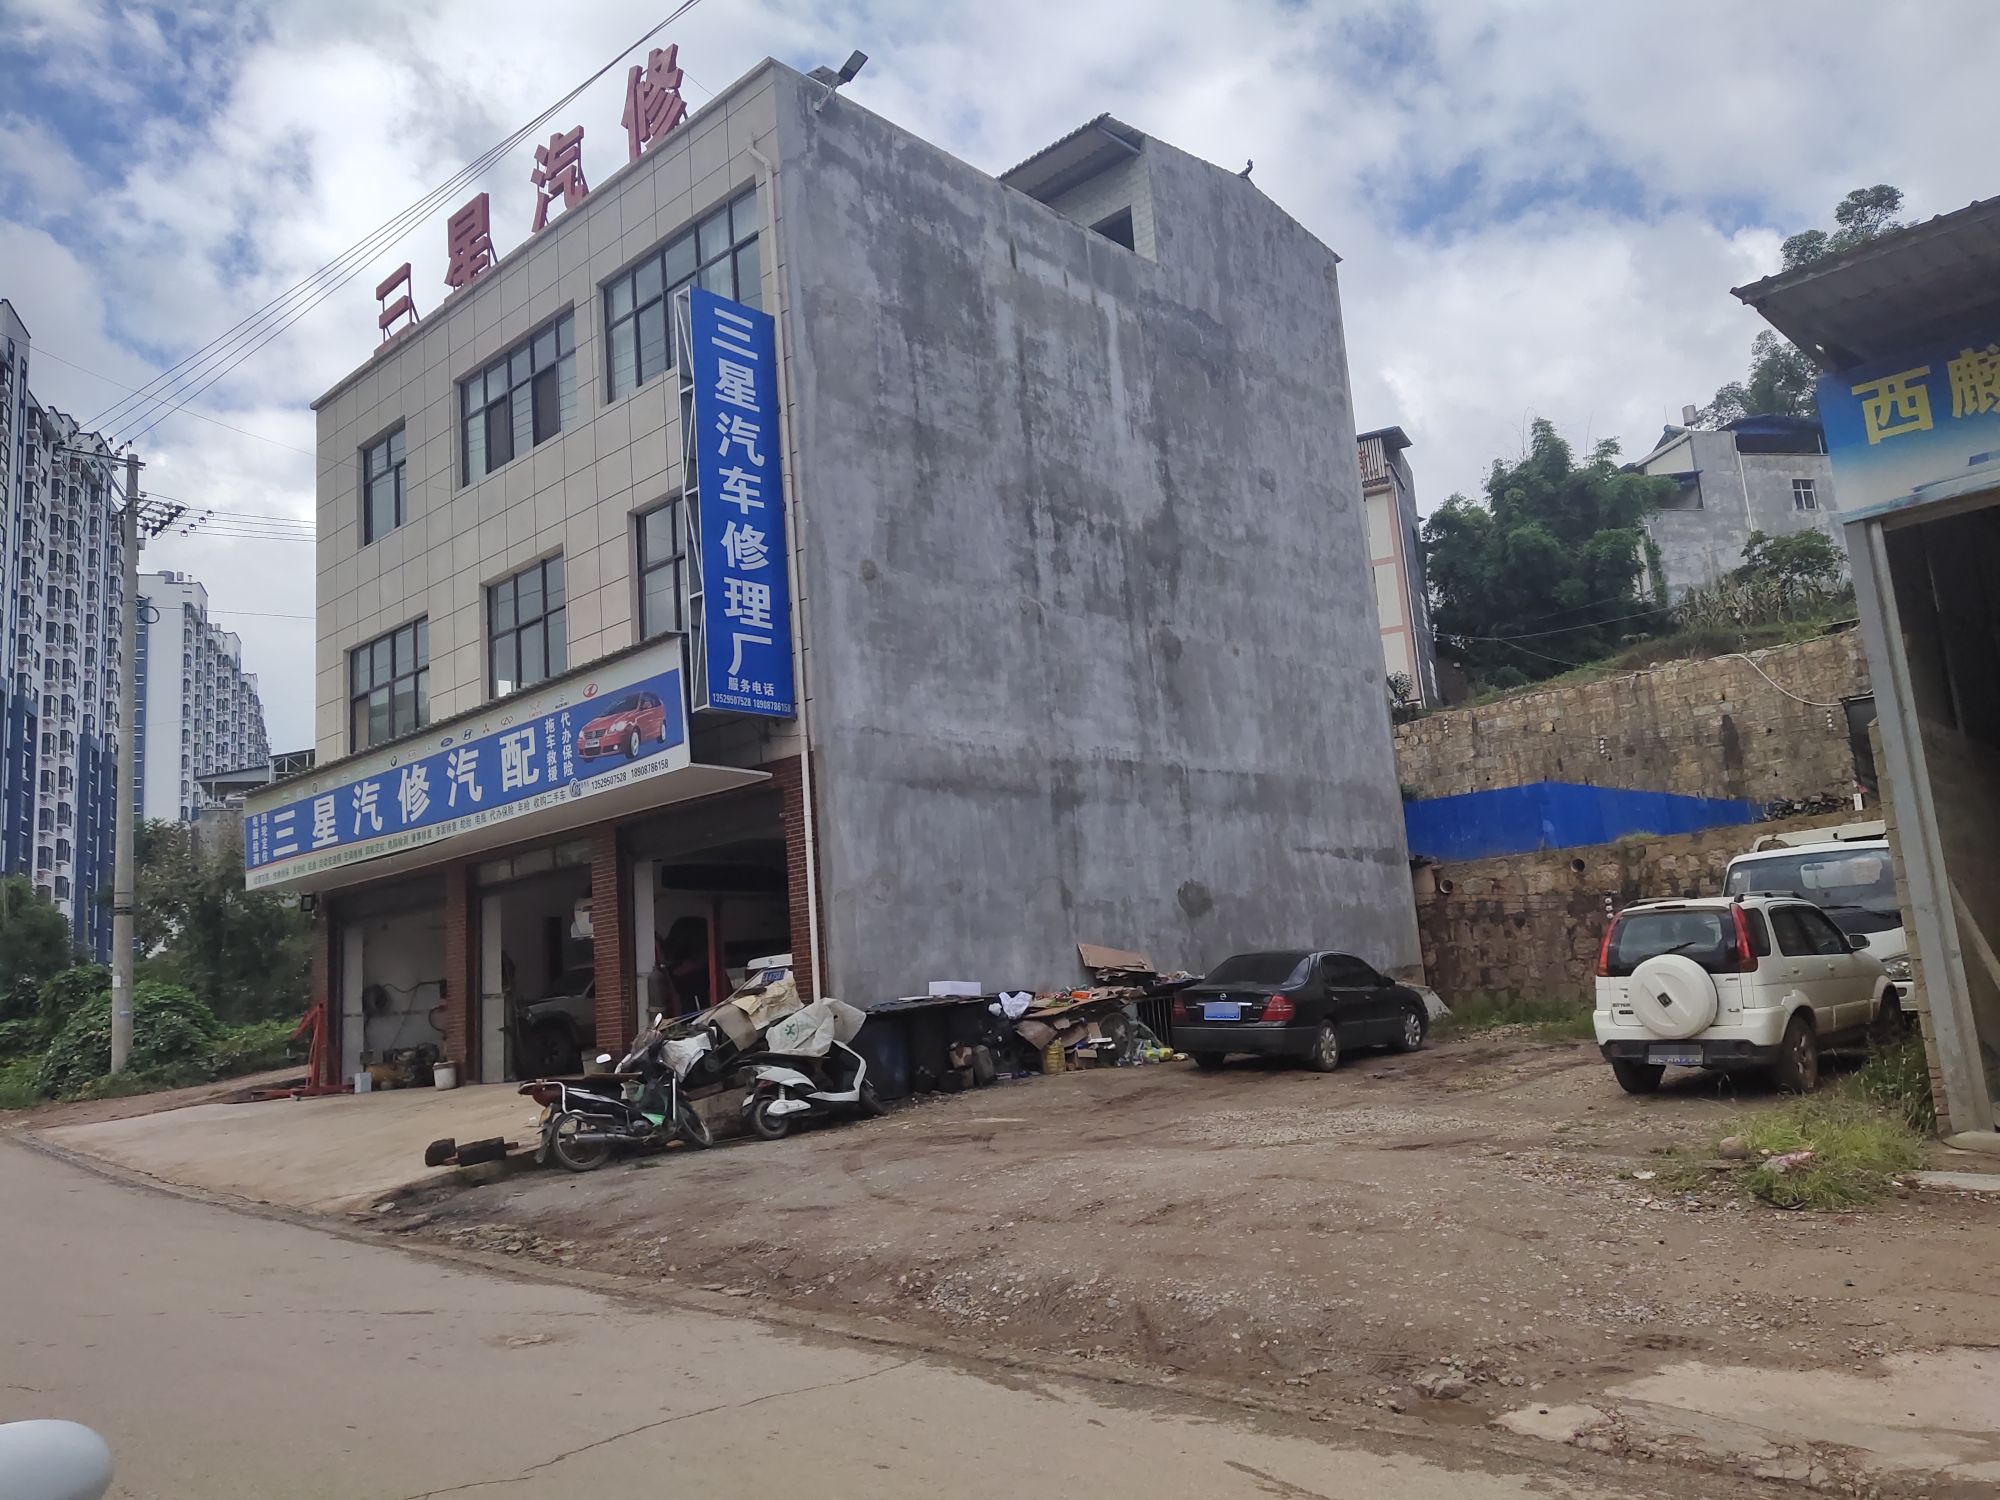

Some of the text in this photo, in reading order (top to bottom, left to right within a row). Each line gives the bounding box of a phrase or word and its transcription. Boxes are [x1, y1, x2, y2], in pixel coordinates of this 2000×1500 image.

[375, 43, 687, 345] 三星汽修
[711, 307, 773, 676] 三星汽车修理厂
[728, 676, 775, 697] 服务电话
[544, 717, 558, 783] 拖车救援
[560, 712, 574, 778] 代办保险
[272, 726, 540, 857] 三星汽修汽配
[489, 804, 514, 821] 代办保险
[533, 789, 567, 808] 收购二手车
